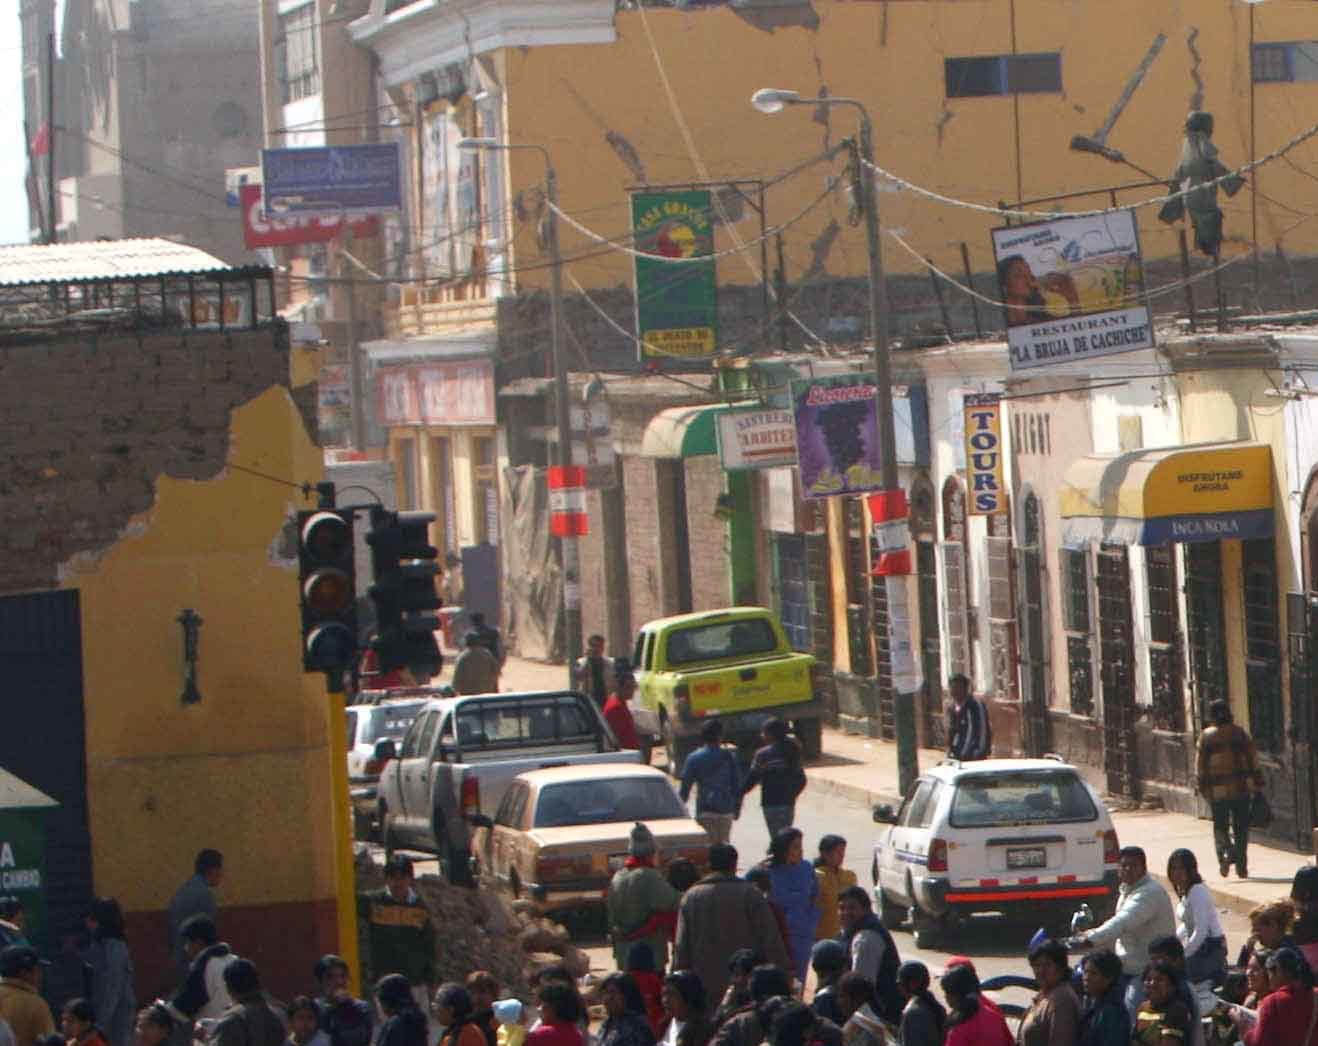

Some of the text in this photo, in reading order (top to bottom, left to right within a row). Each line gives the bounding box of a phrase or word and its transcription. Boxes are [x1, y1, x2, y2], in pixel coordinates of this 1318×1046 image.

[1031, 315, 1129, 338] RESTAURANT
[1034, 338, 1072, 358] BRUJA
[1073, 334, 1090, 352] DE
[970, 411, 998, 512] TOURS
